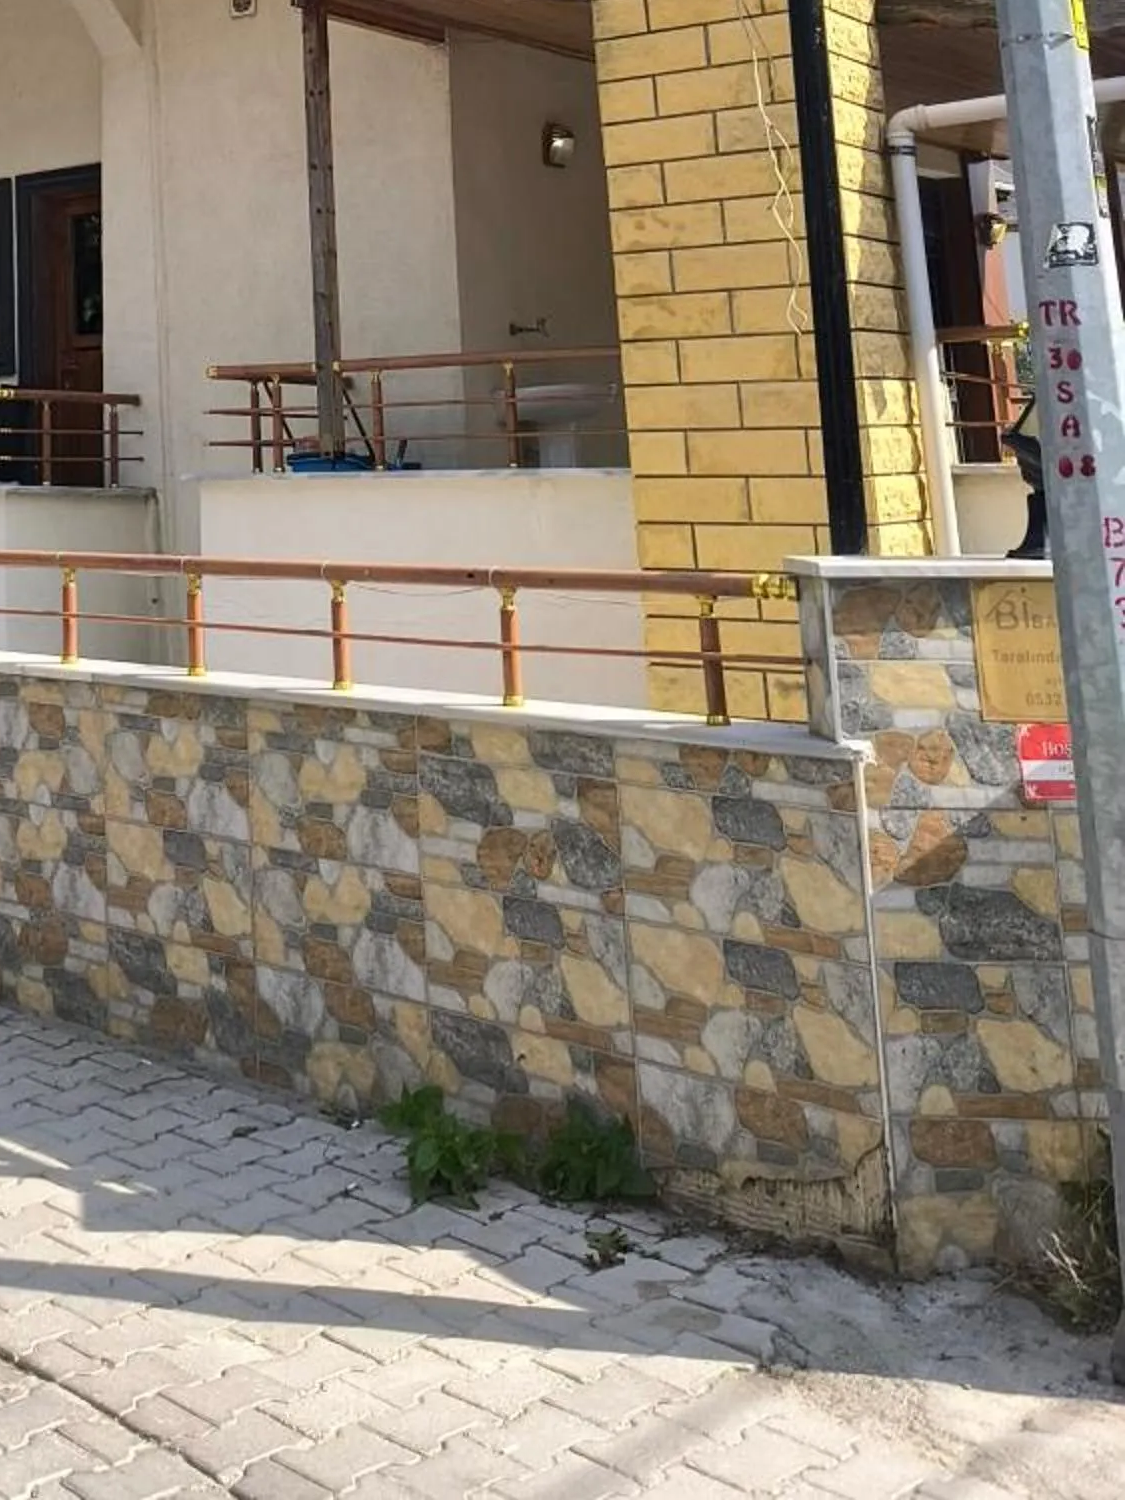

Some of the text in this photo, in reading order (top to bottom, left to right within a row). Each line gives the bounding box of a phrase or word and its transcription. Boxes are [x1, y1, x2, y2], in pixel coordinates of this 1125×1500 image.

[1039, 300, 1081, 327] TR
[1056, 381, 1075, 404] S
[1061, 413, 1081, 438] A
